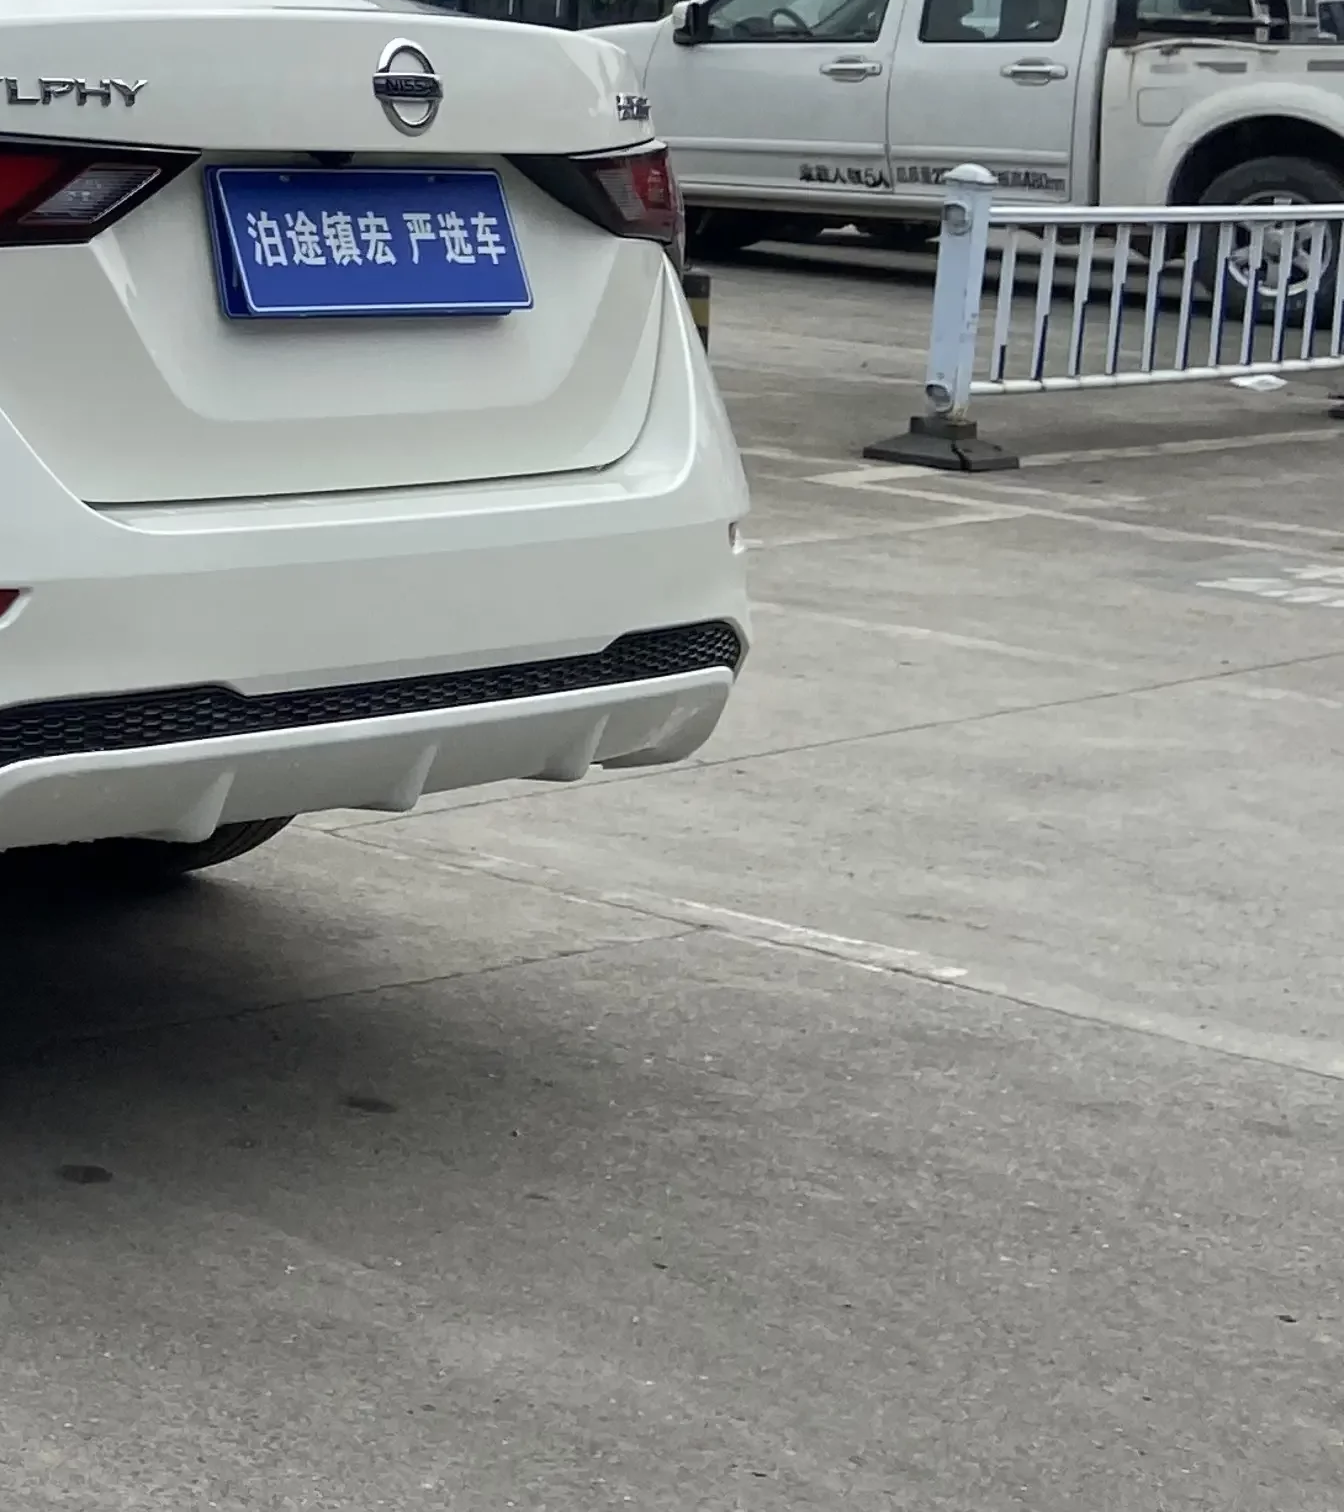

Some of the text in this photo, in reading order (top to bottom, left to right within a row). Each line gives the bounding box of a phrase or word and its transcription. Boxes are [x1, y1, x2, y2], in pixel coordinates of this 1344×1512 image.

[385, 78, 440, 94] NISS
[246, 210, 506, 266] 泊途镇宏 严选车
